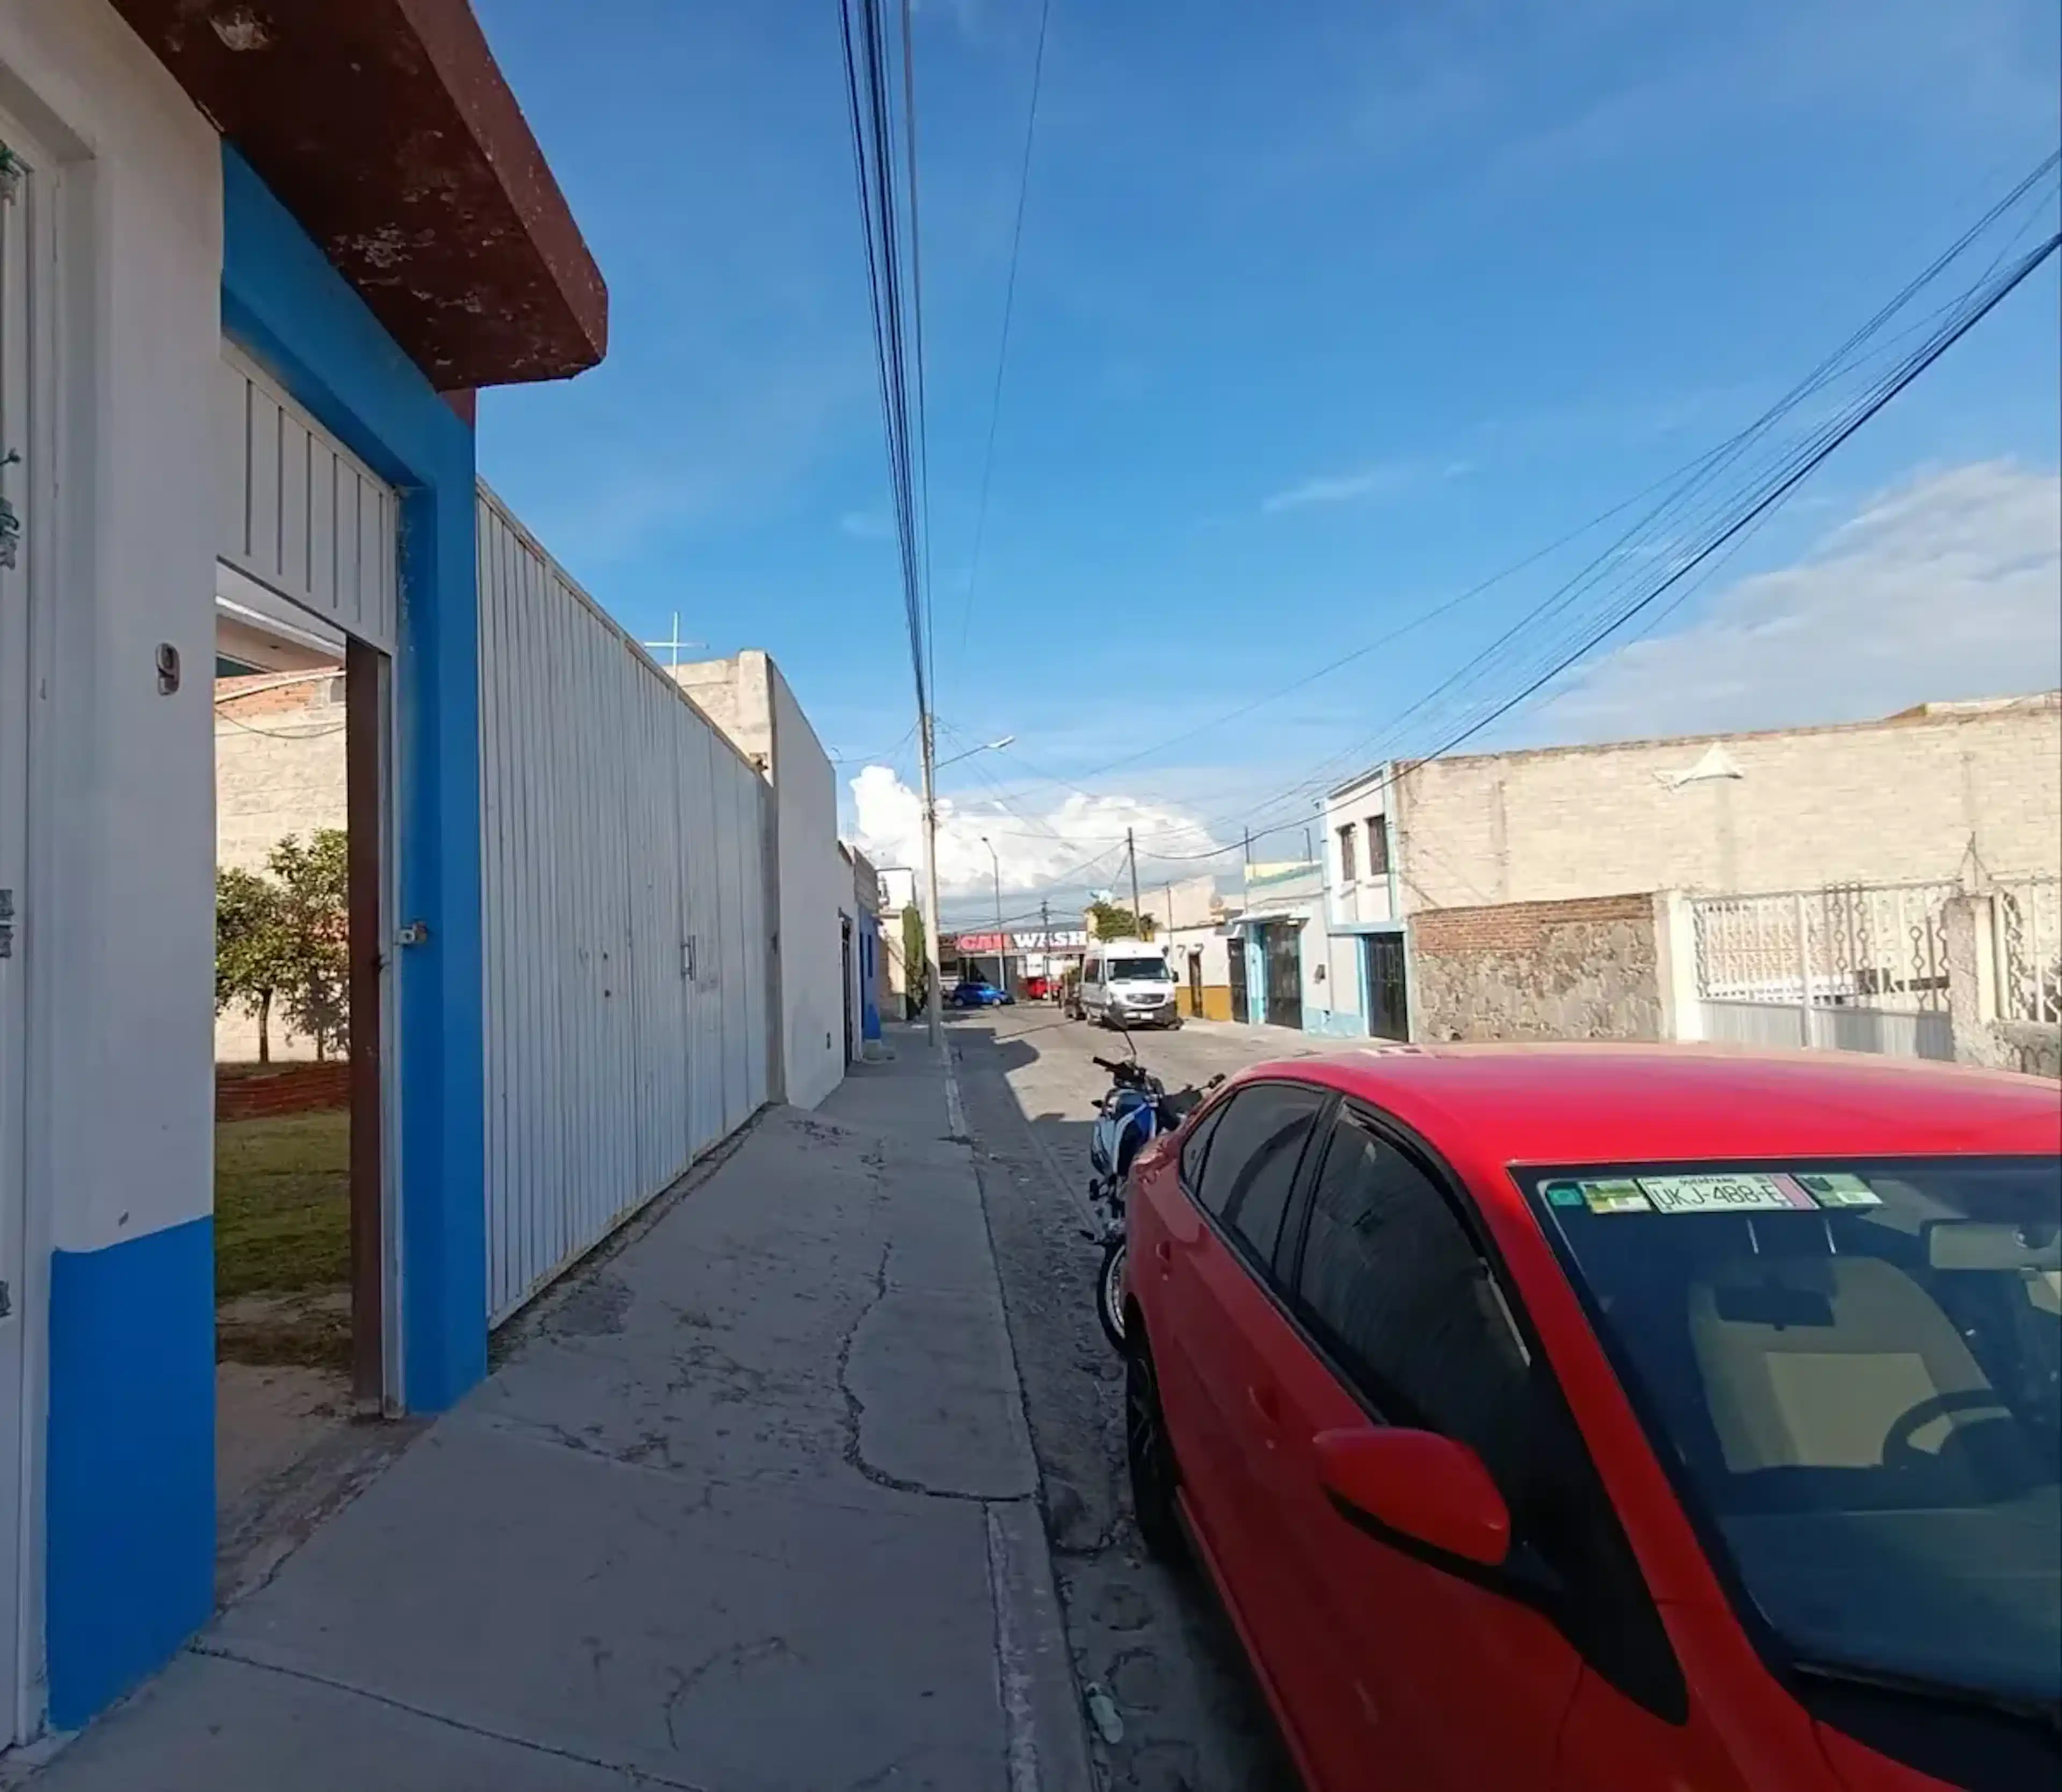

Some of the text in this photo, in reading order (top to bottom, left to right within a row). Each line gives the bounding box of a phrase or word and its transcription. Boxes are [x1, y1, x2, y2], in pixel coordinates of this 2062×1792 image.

[155, 642, 180, 696] 9
[1013, 931, 1087, 948] WASH
[1653, 1185, 1787, 1206] UKJ-488-E
